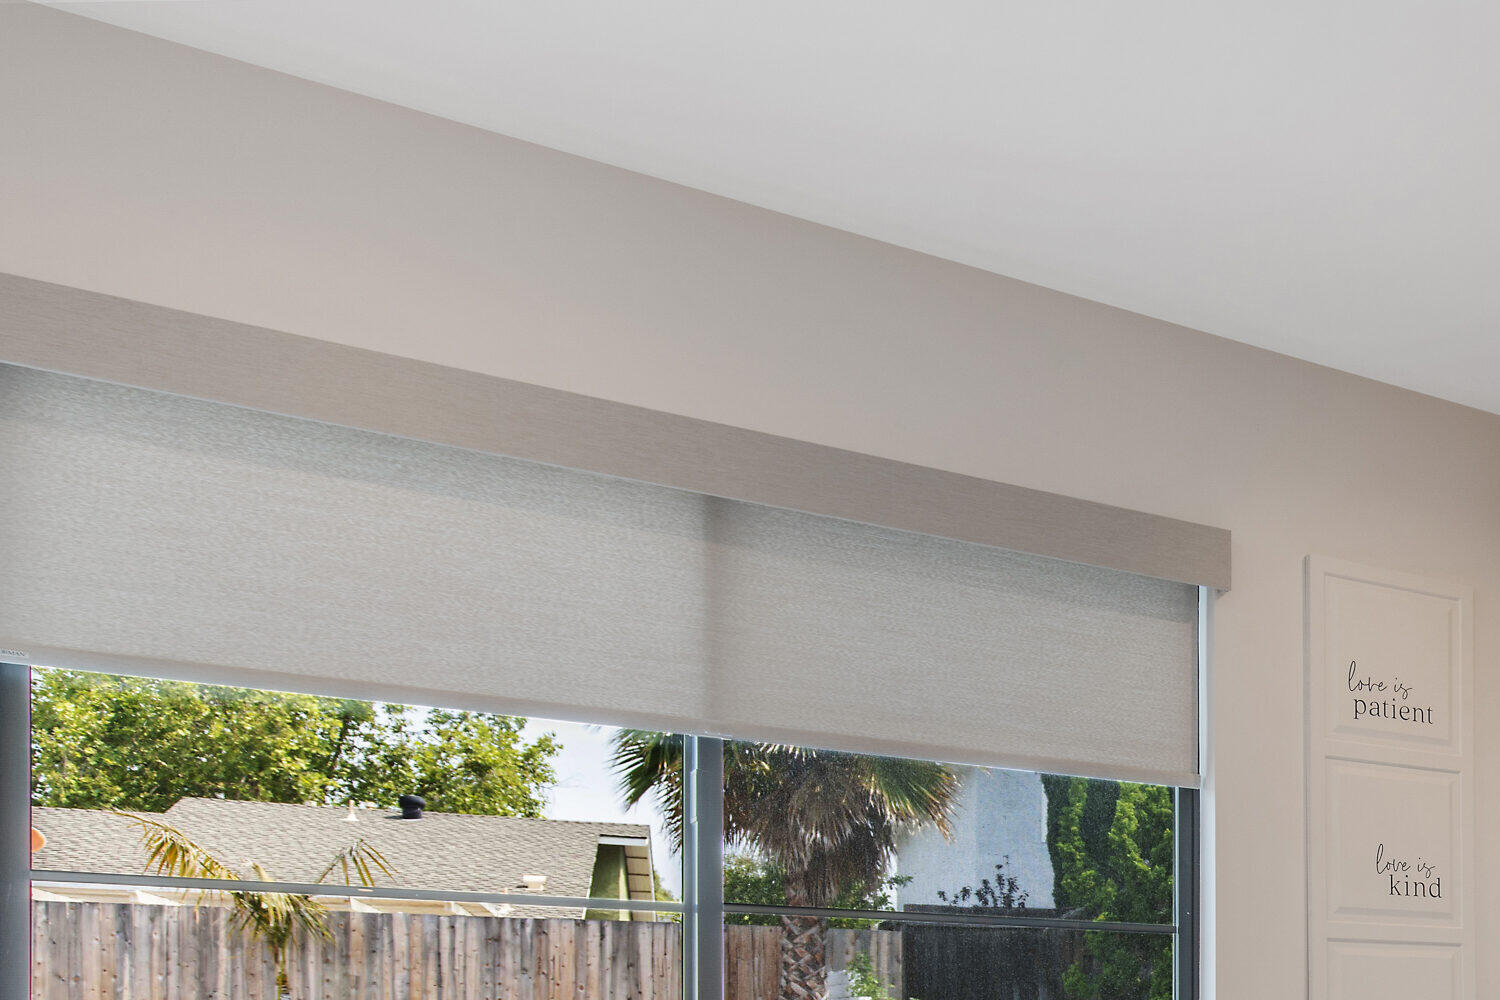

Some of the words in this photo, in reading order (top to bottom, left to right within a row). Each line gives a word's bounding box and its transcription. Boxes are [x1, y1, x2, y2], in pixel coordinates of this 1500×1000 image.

[1348, 660, 1387, 693] love
[1394, 675, 1413, 699] is
[1353, 696, 1434, 725] patient
[1376, 843, 1411, 875] love
[1417, 856, 1436, 879] is
[1389, 874, 1443, 899] kind
